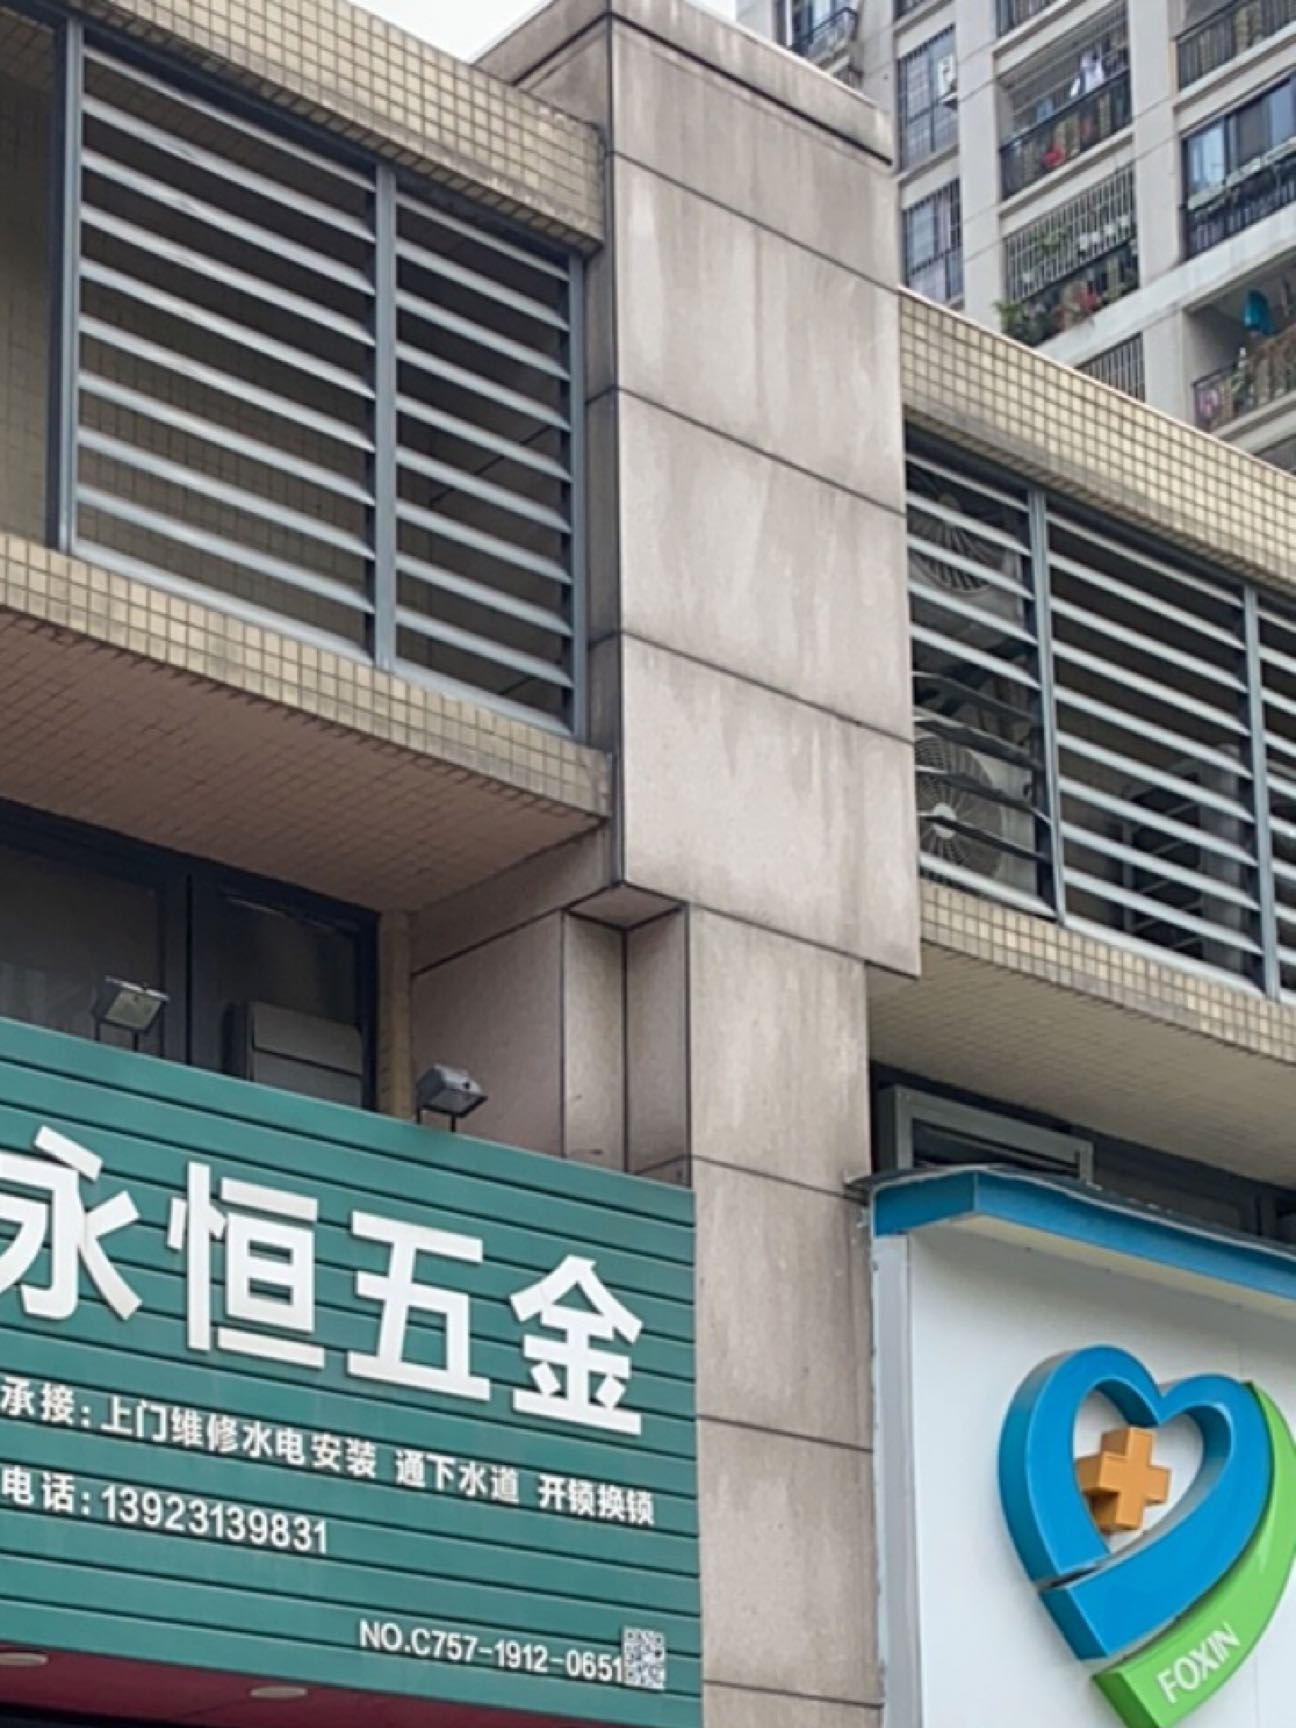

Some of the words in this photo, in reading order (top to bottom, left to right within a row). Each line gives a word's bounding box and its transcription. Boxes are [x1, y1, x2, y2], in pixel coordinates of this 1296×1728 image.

[394, 1448, 520, 1505] 通下水道
[537, 1473, 655, 1525] 开锁换锁
[358, 1619, 623, 1683] NO.C757-1912-0651
[1155, 1621, 1241, 1705] FOXIN
